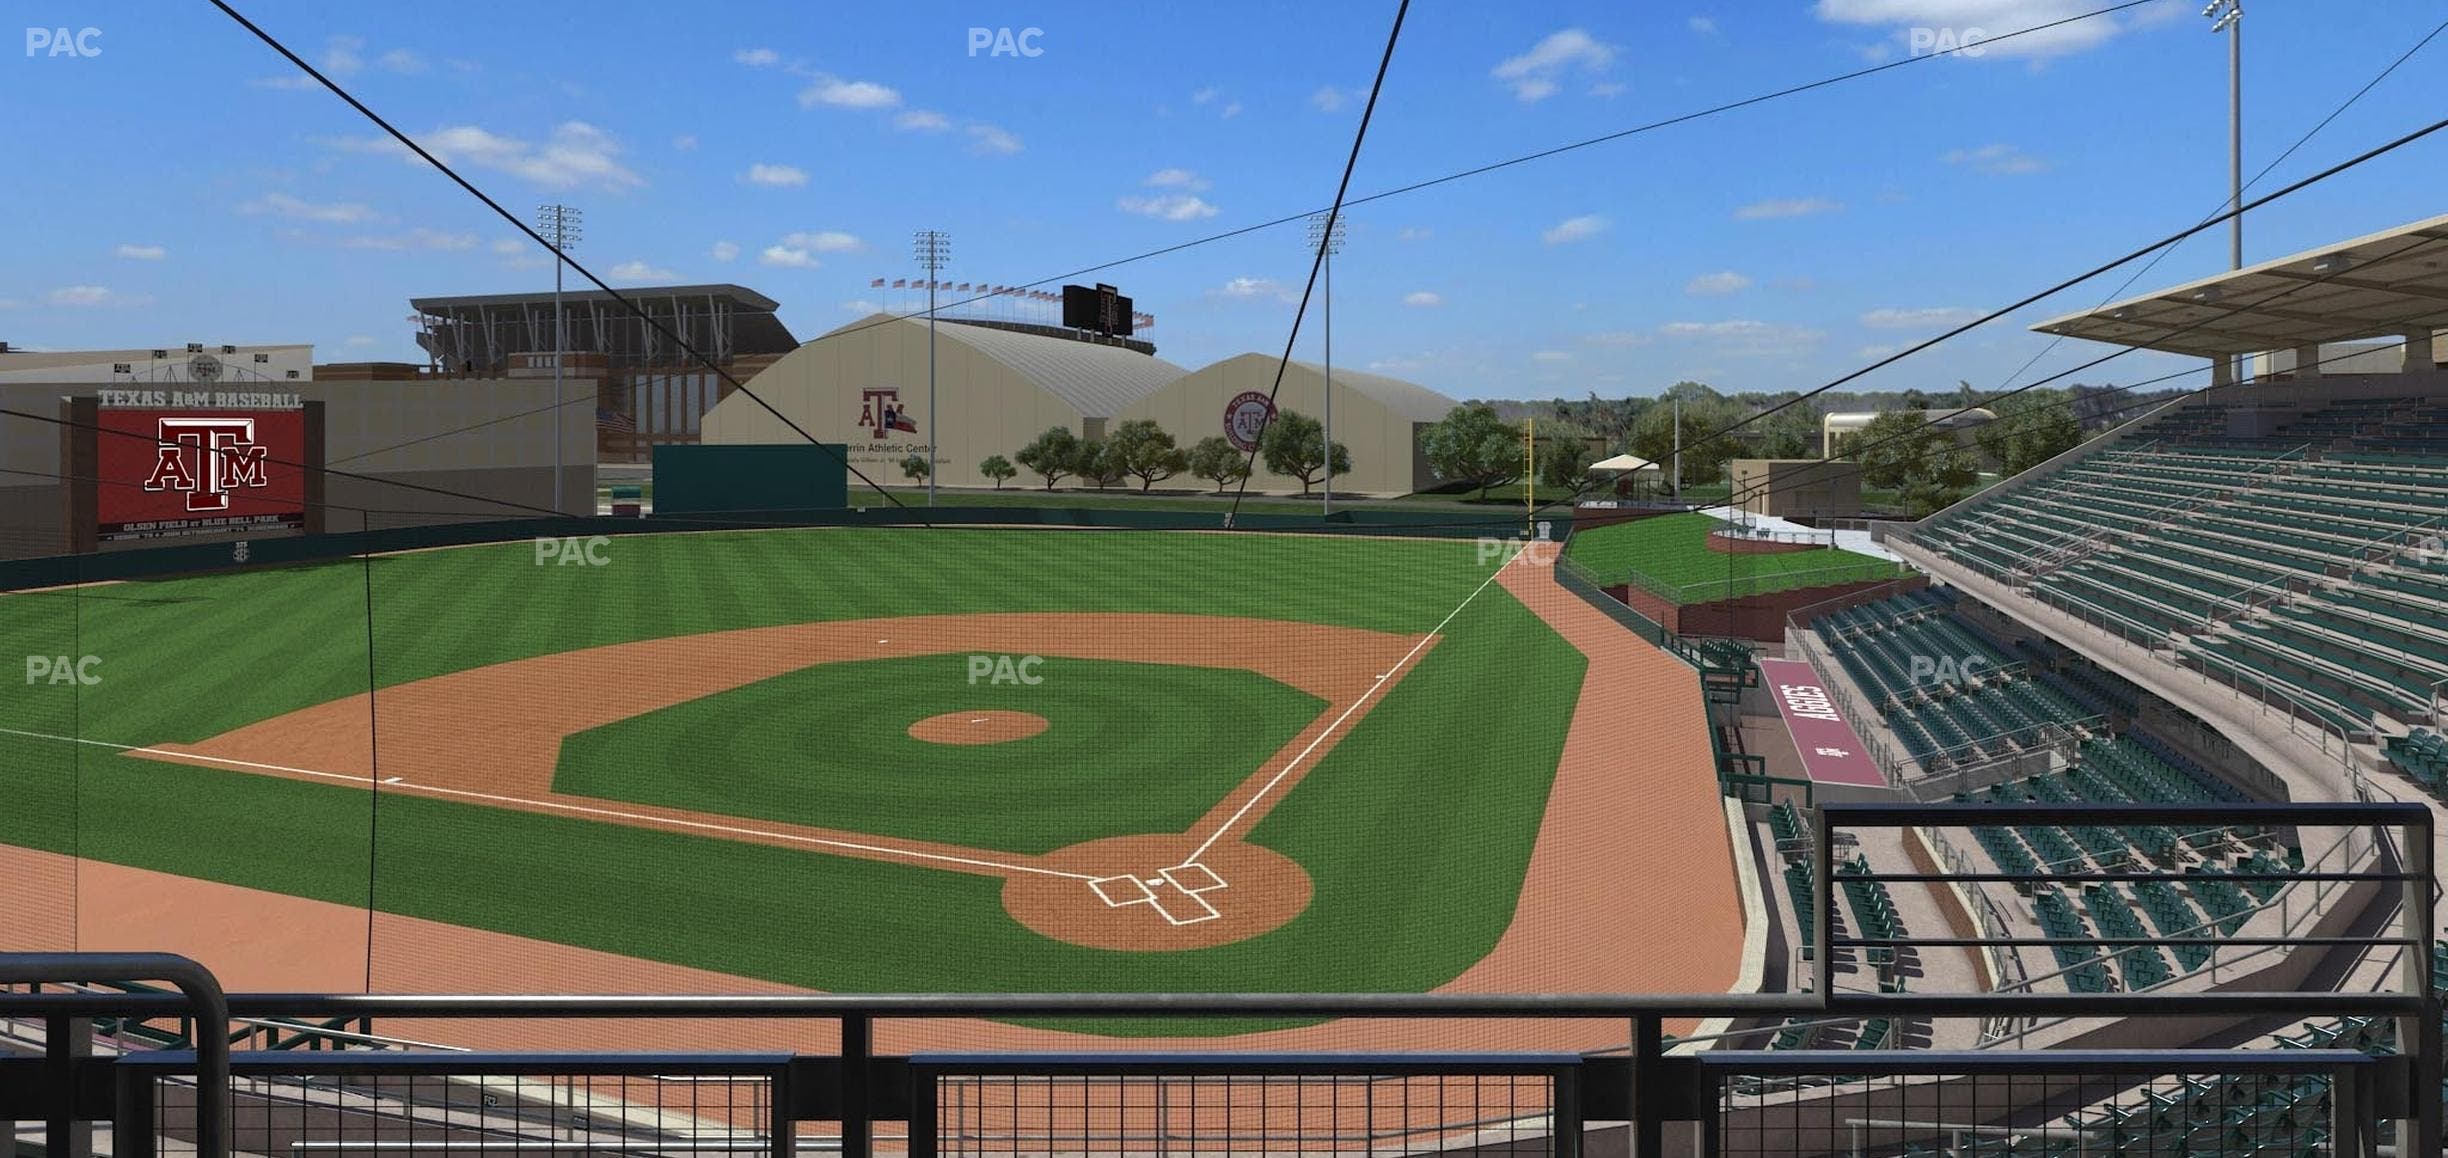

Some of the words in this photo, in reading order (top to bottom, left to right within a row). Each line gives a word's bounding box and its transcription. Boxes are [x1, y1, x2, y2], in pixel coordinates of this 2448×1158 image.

[98, 390, 166, 408] TEXAS
[172, 391, 209, 408] A&M
[215, 392, 304, 409] BASEBALL
[868, 443, 903, 453] Athletic
[123, 522, 157, 532] OLSEN
[159, 520, 188, 530] FIELD
[202, 518, 227, 527] BLUE
[229, 517, 251, 526] BELL
[254, 515, 279, 524] PARK
[1780, 684, 1841, 721] AGGIES
